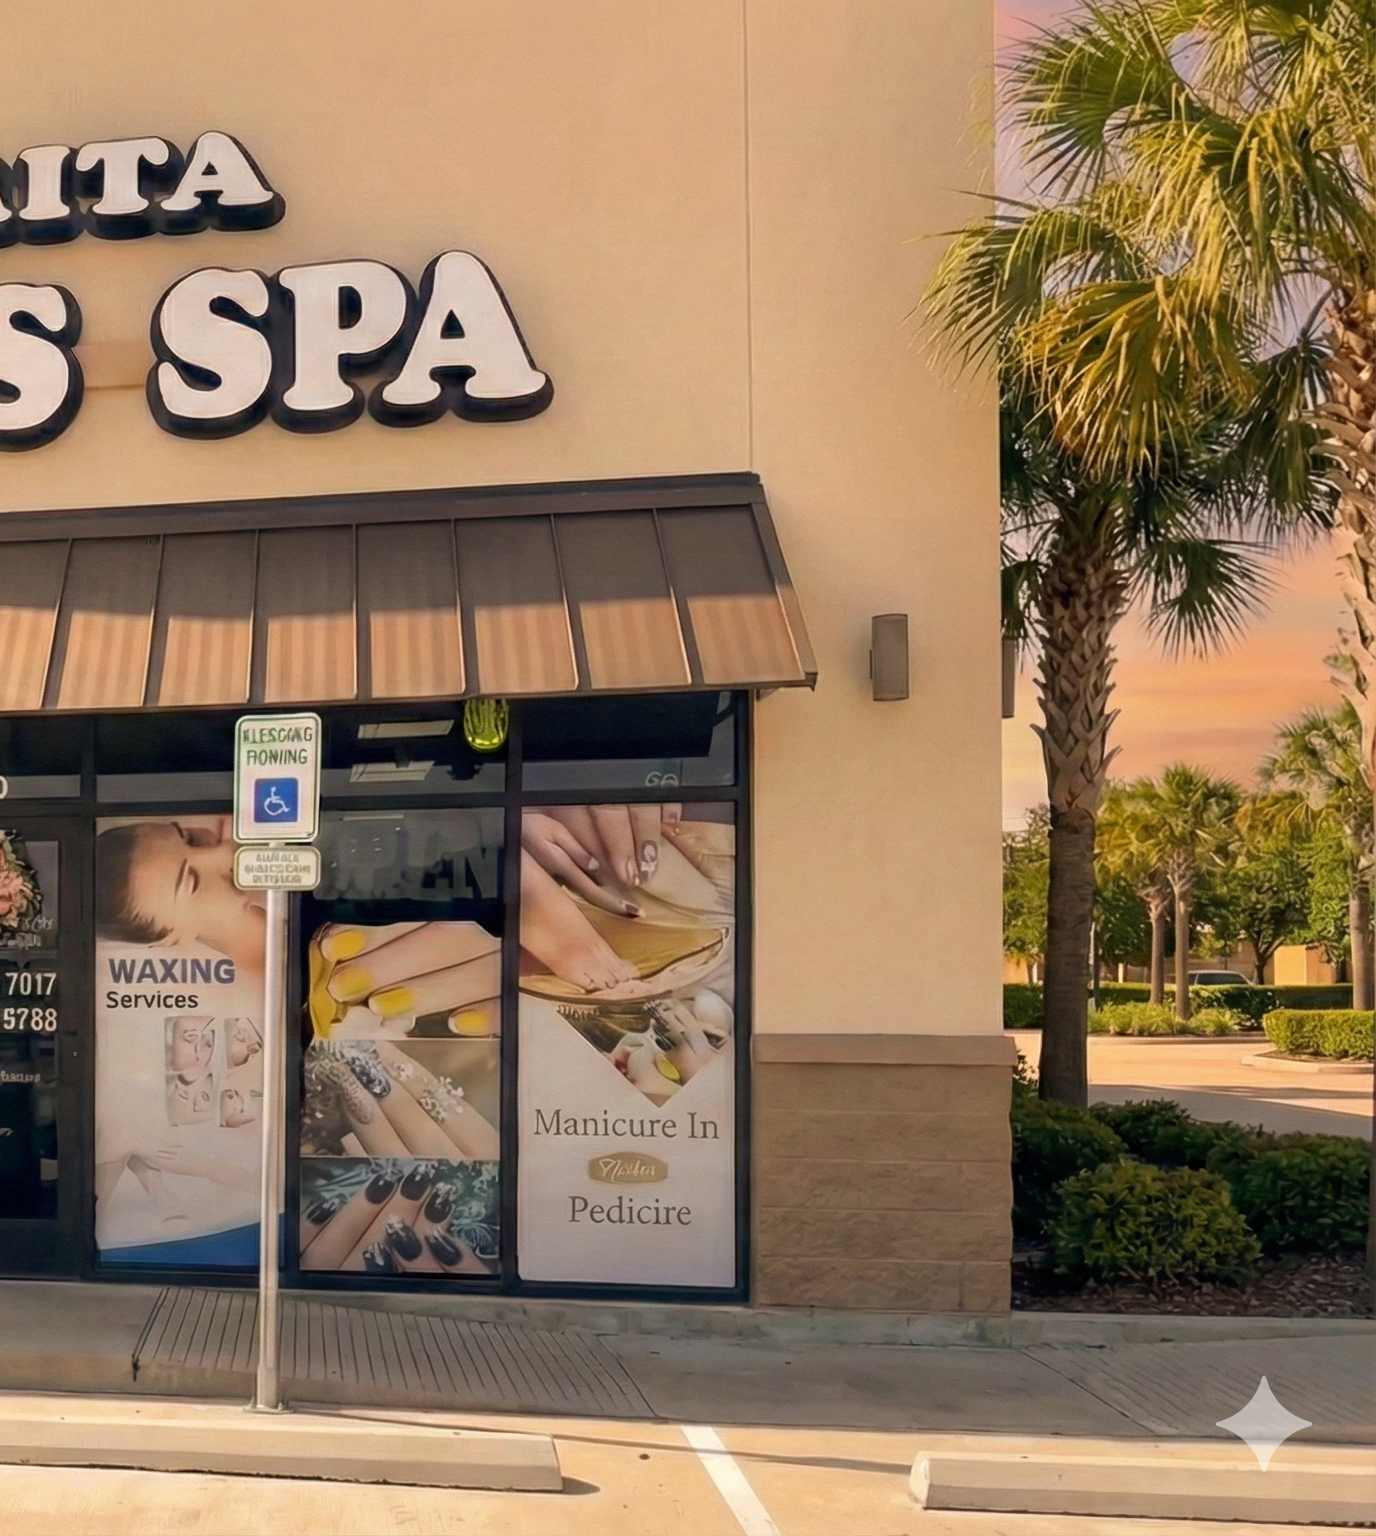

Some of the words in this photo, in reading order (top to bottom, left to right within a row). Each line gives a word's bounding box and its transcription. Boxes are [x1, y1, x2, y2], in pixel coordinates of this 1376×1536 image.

[146, 250, 554, 439] SPA
[5, 972, 57, 996] 7017
[108, 958, 236, 985] WAXING
[106, 991, 199, 1009] Services
[534, 1108, 677, 1138] Manicure
[687, 1112, 720, 1139] In
[568, 1196, 692, 1225] Pedicire
